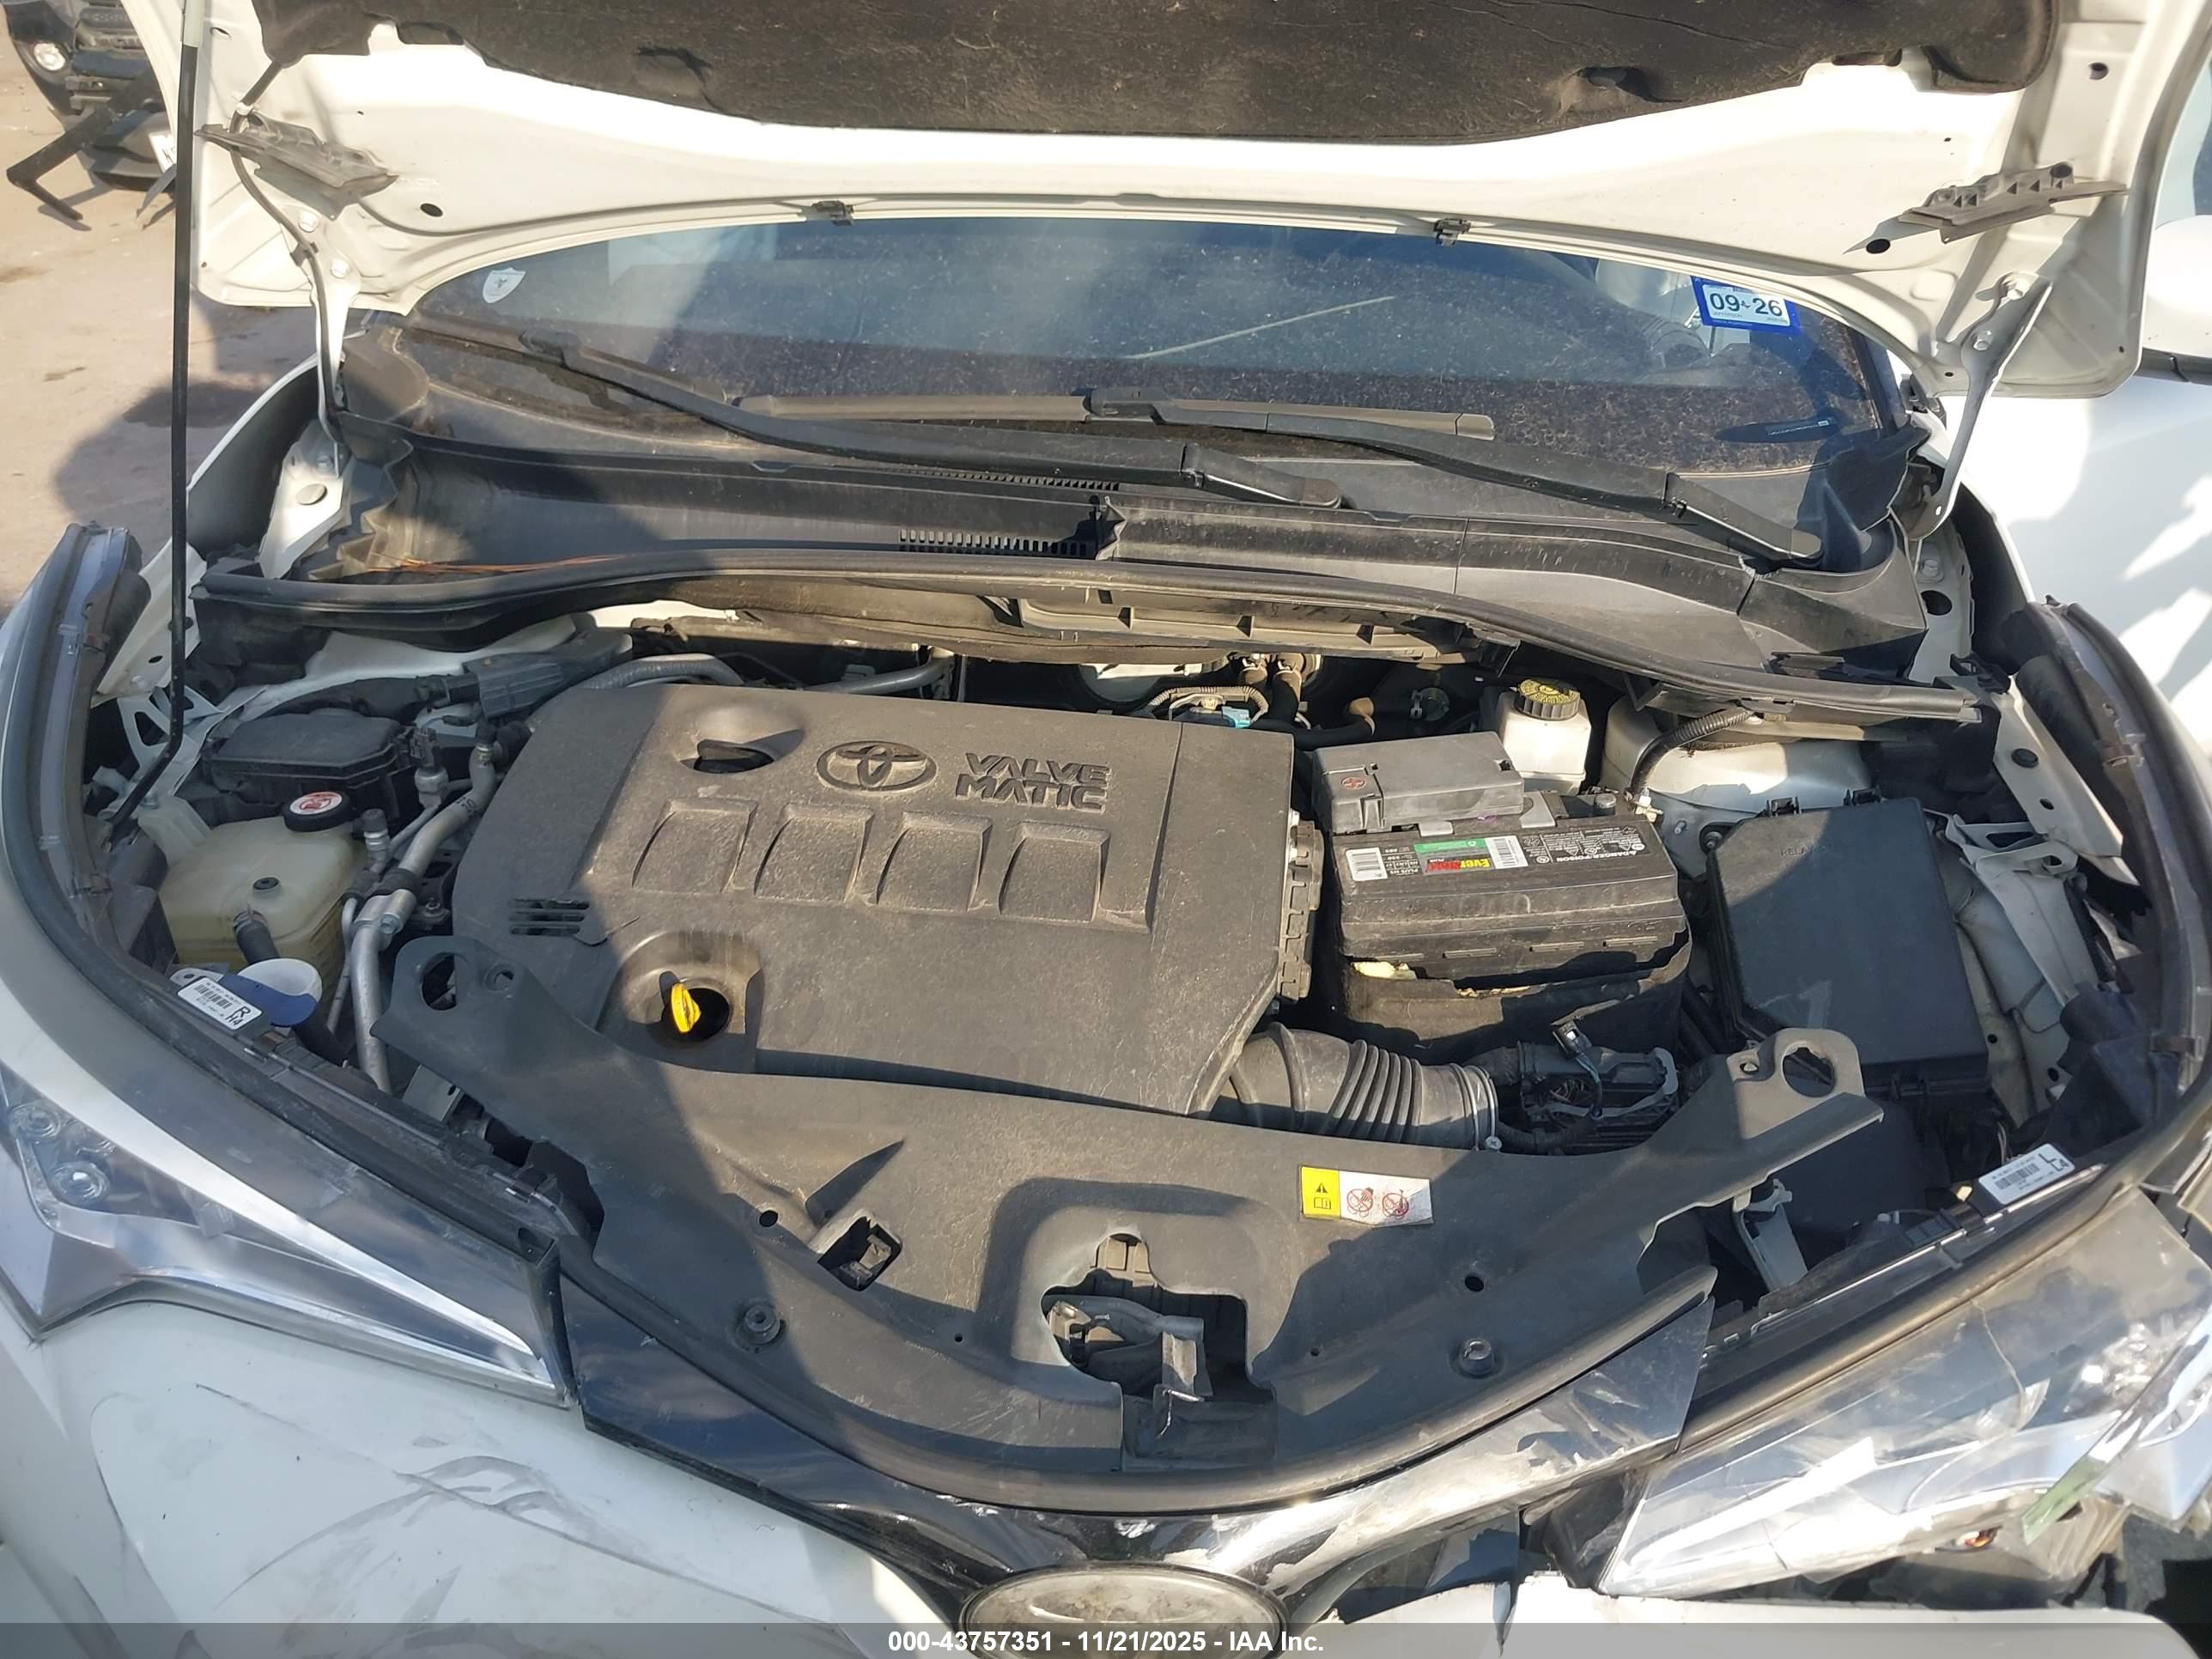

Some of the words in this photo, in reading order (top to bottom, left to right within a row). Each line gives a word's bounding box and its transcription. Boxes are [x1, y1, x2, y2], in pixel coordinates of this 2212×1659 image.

[1710, 293, 1740, 312] 09
[1753, 297, 1783, 316] 26
[965, 752, 1112, 788] VALVE
[955, 773, 1108, 814] MATIC
[234, 1005, 252, 1018] R
